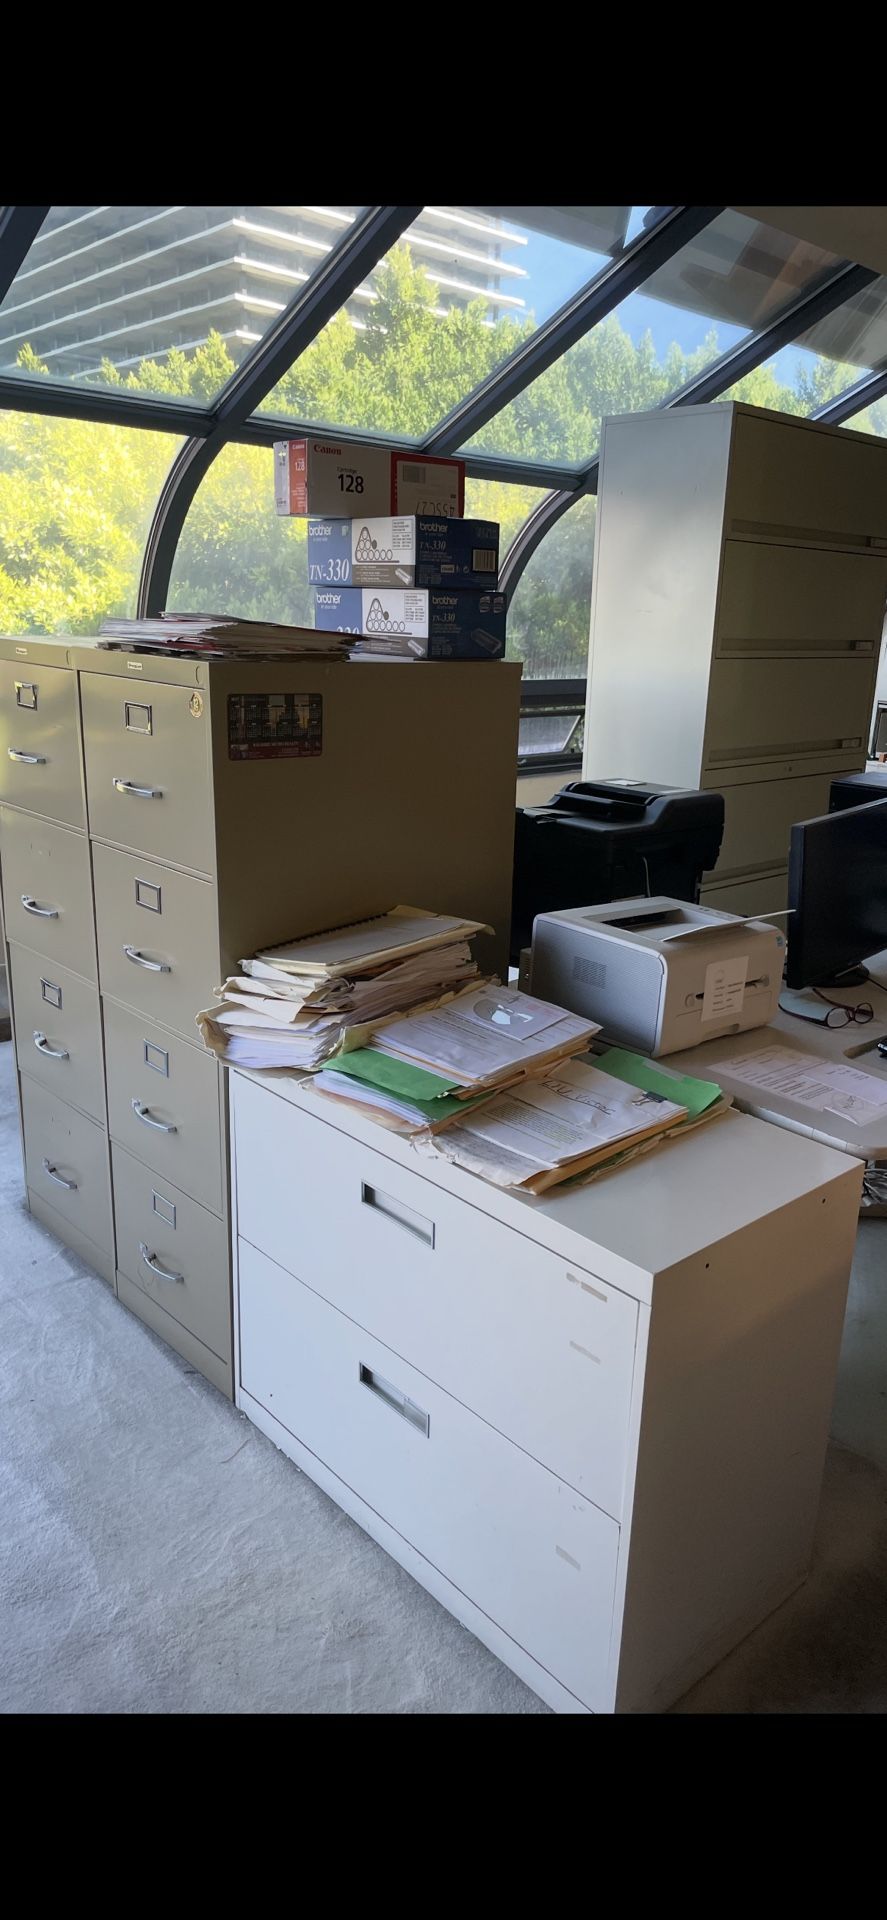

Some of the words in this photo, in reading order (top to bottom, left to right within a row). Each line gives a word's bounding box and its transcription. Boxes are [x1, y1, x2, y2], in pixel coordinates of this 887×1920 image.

[313, 444, 342, 456] Canon
[295, 461, 305, 472] 128
[337, 473, 364, 494] 128
[308, 524, 332, 536] brother
[419, 522, 449, 532] brother
[309, 558, 350, 582] TN-330
[316, 592, 342, 604] brother
[432, 596, 458, 605] brother
